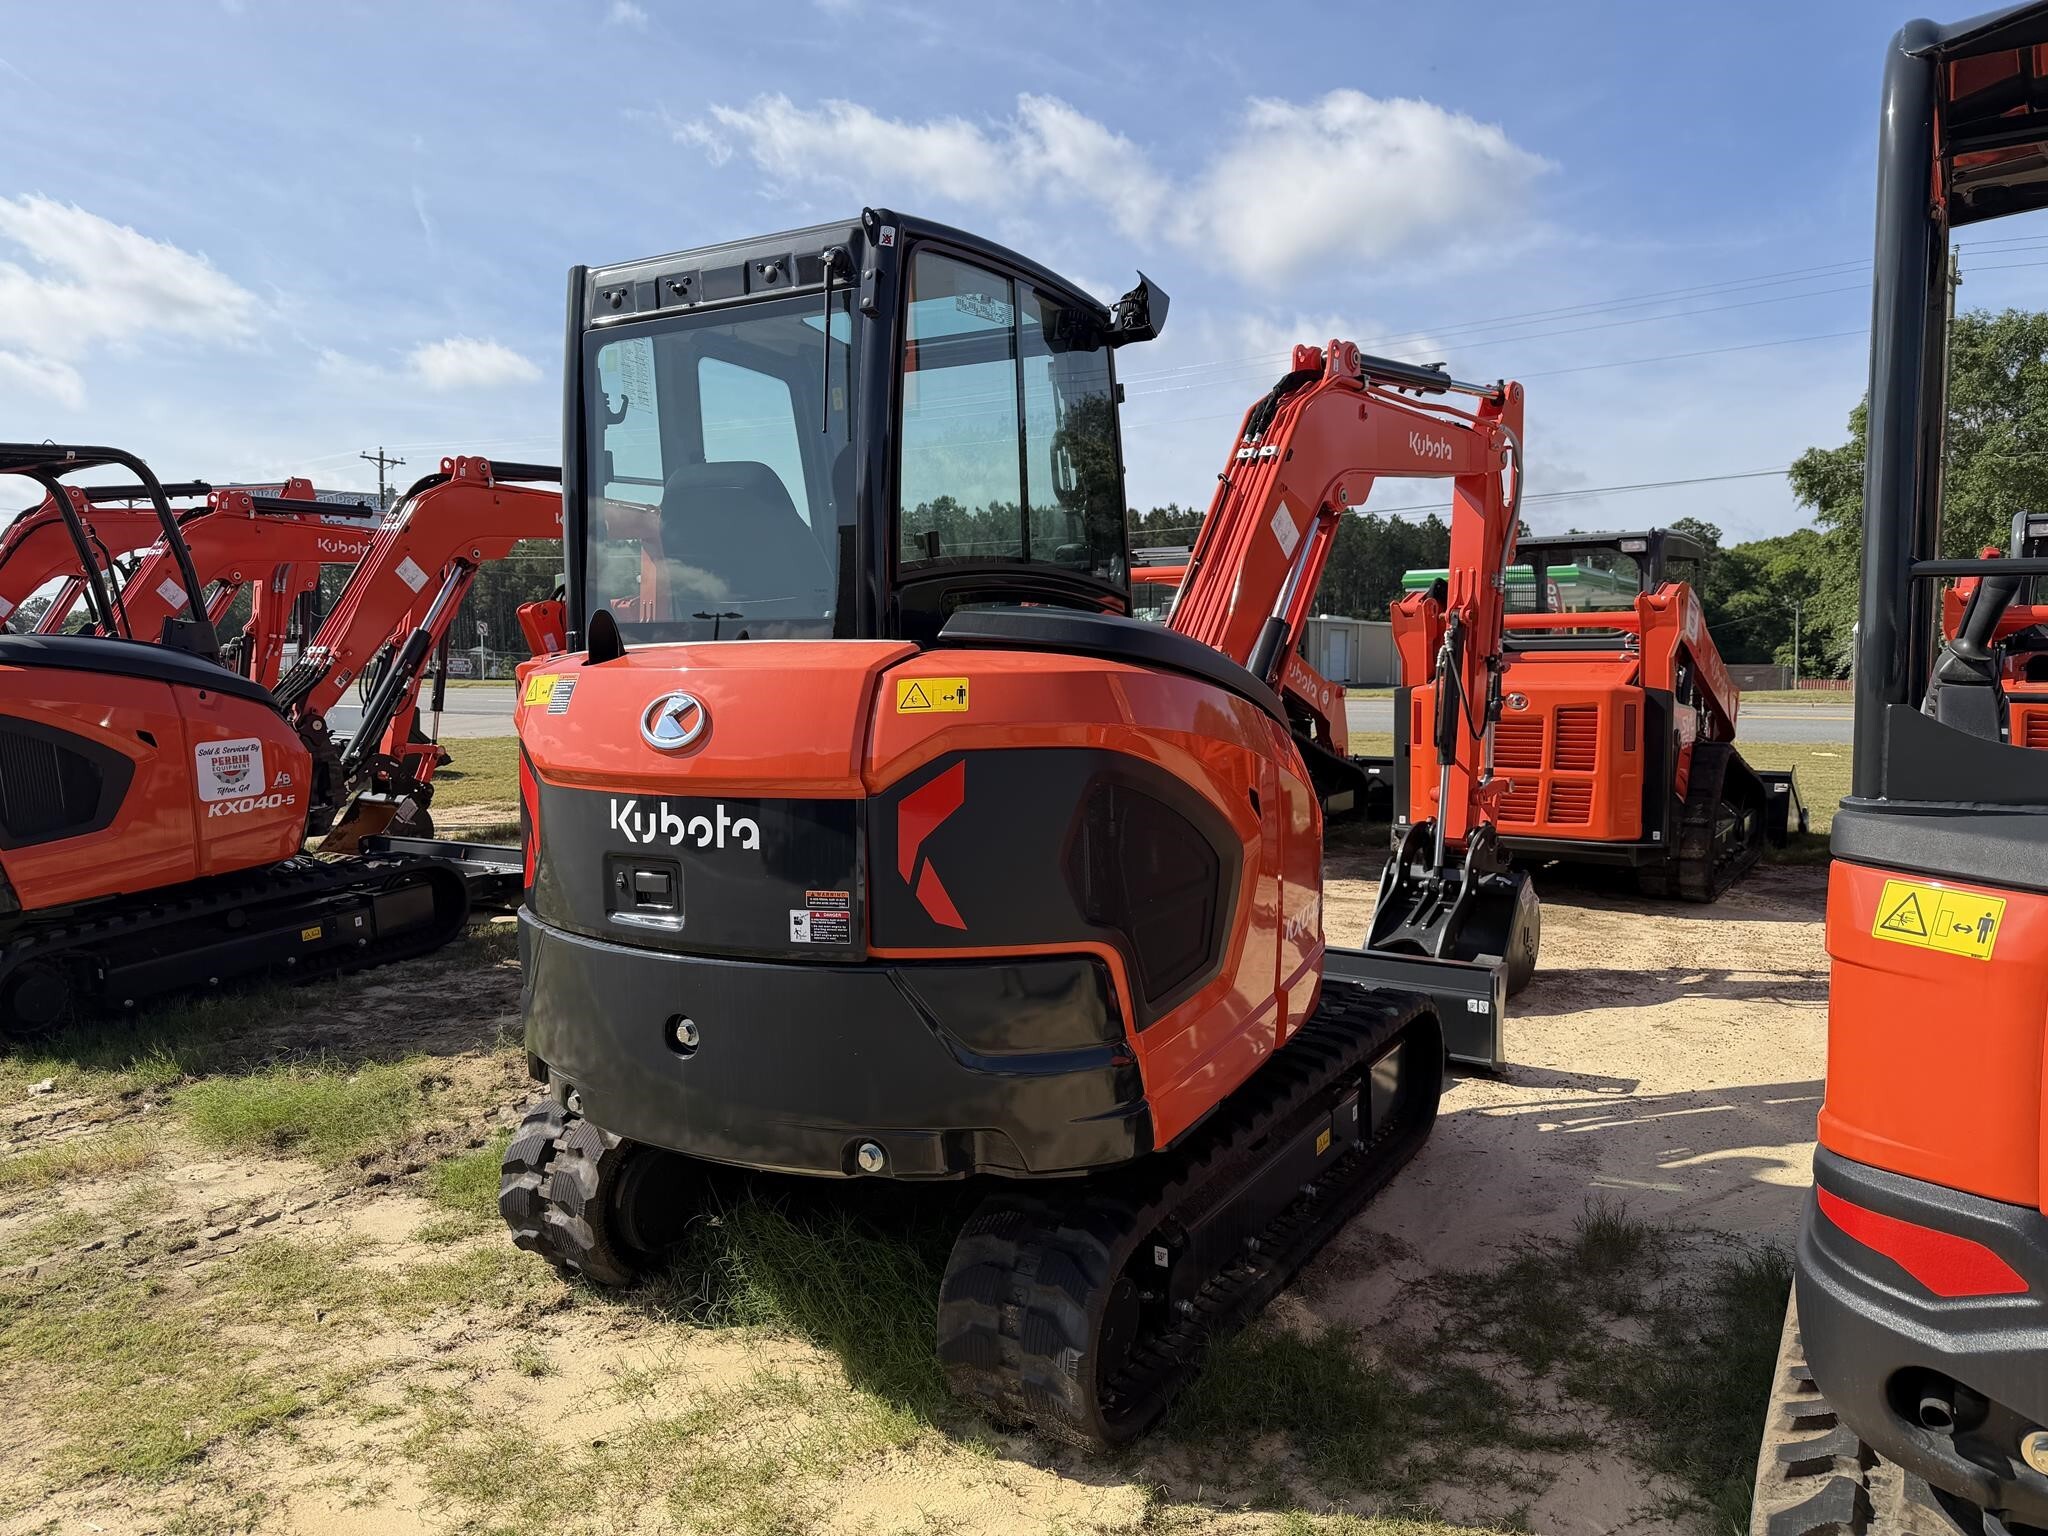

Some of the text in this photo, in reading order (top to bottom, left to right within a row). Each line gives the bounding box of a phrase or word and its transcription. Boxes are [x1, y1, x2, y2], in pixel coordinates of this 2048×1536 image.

[1409, 431, 1452, 460] Kubota
[1289, 661, 1318, 699] ubota
[198, 747, 213, 757] Sold
[222, 745, 250, 754] Serviced
[250, 743, 260, 753] By
[211, 754, 250, 767] PERRIN
[212, 763, 250, 772] EQUIPMENT
[239, 783, 251, 793] GA
[610, 798, 760, 850] Kubota
